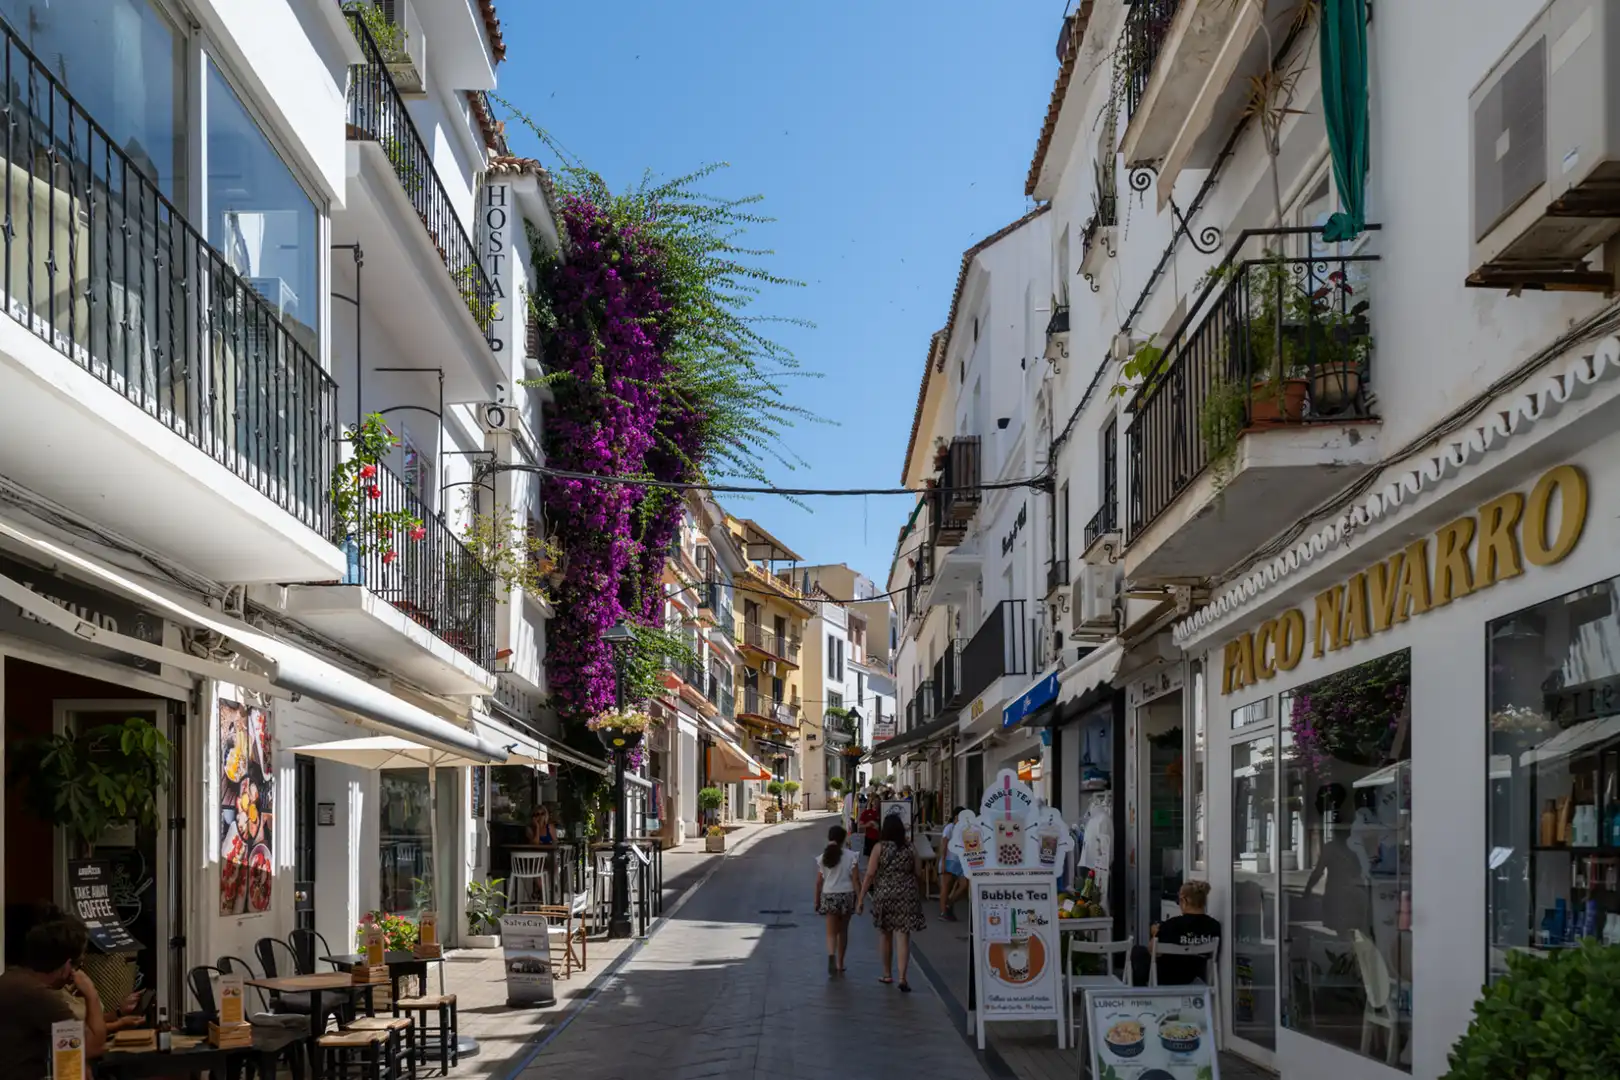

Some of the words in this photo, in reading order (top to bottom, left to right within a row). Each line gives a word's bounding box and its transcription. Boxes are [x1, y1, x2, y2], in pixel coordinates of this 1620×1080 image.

[1221, 608, 1306, 695] PACO
[1312, 464, 1588, 658] NAVARRO
[984, 789, 1012, 809] BUBBLE
[1016, 790, 1032, 806] TEA
[73, 886, 91, 900] TAKE
[91, 885, 108, 898] AWAY
[981, 890, 1023, 900] Bubble
[1025, 890, 1048, 900] Tea
[77, 899, 115, 919] COFFEE
[1093, 999, 1124, 1008] LUNCH
